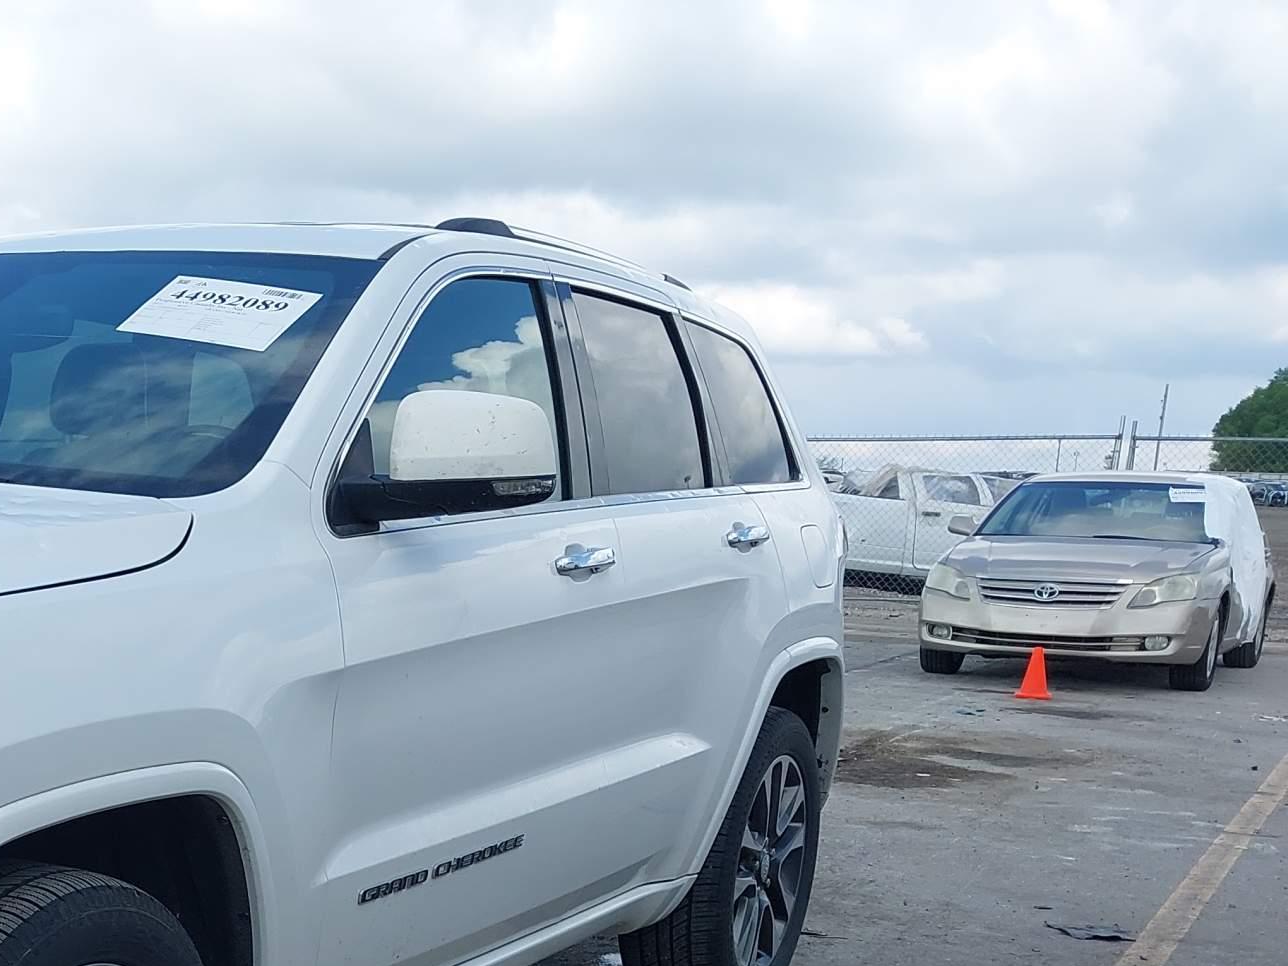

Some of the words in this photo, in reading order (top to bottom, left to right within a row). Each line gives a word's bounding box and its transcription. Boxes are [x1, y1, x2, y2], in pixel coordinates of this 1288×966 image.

[170, 289, 289, 312] 44982089
[358, 869, 429, 905] GRAND
[431, 834, 525, 880] CHEROKEE
